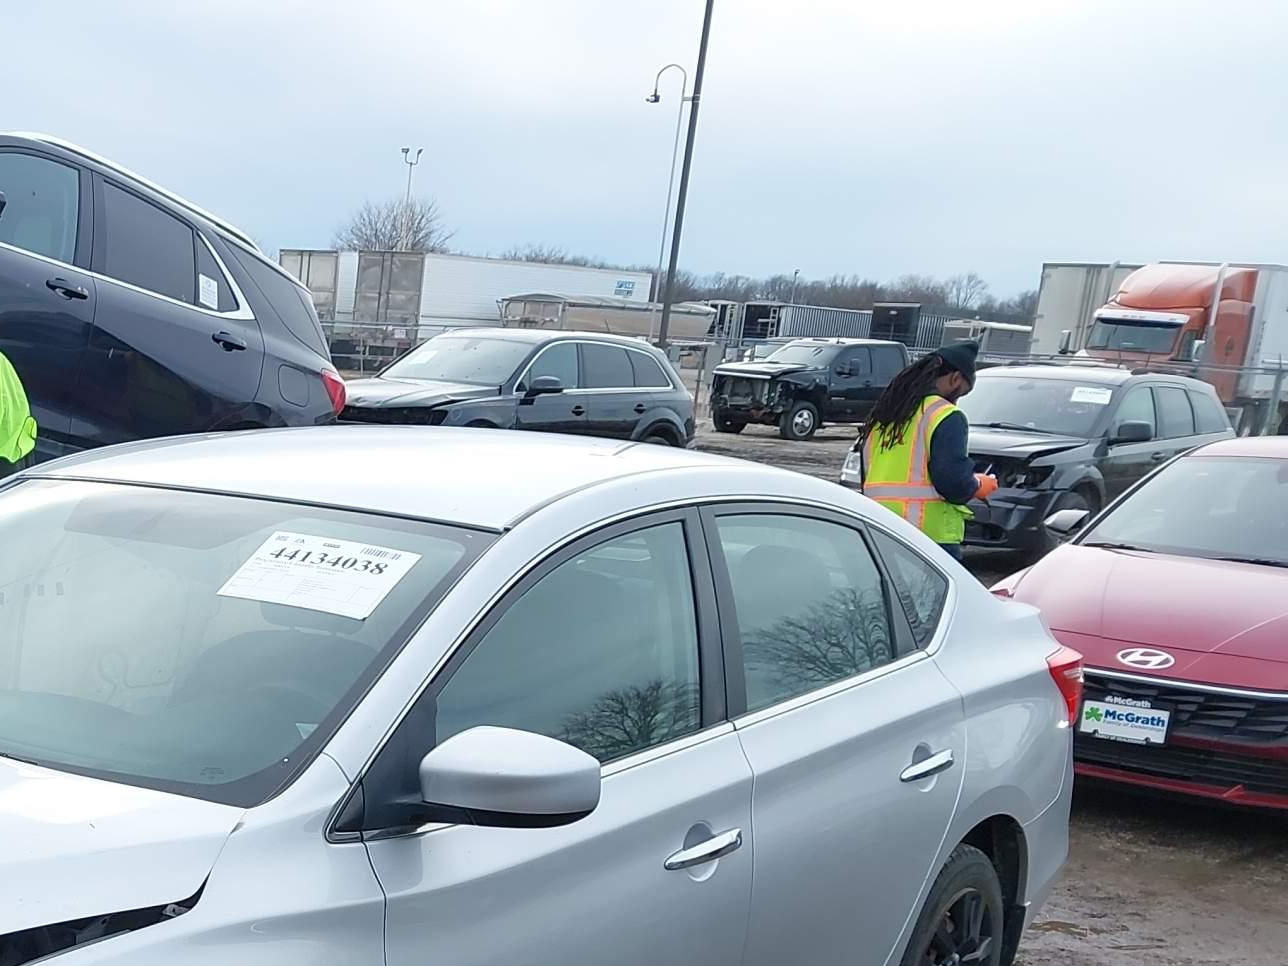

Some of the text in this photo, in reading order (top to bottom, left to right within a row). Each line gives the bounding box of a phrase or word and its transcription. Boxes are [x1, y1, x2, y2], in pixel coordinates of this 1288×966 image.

[269, 546, 389, 575] 44134038
[1114, 696, 1152, 708] McGrath
[1104, 709, 1166, 727] McGrath
